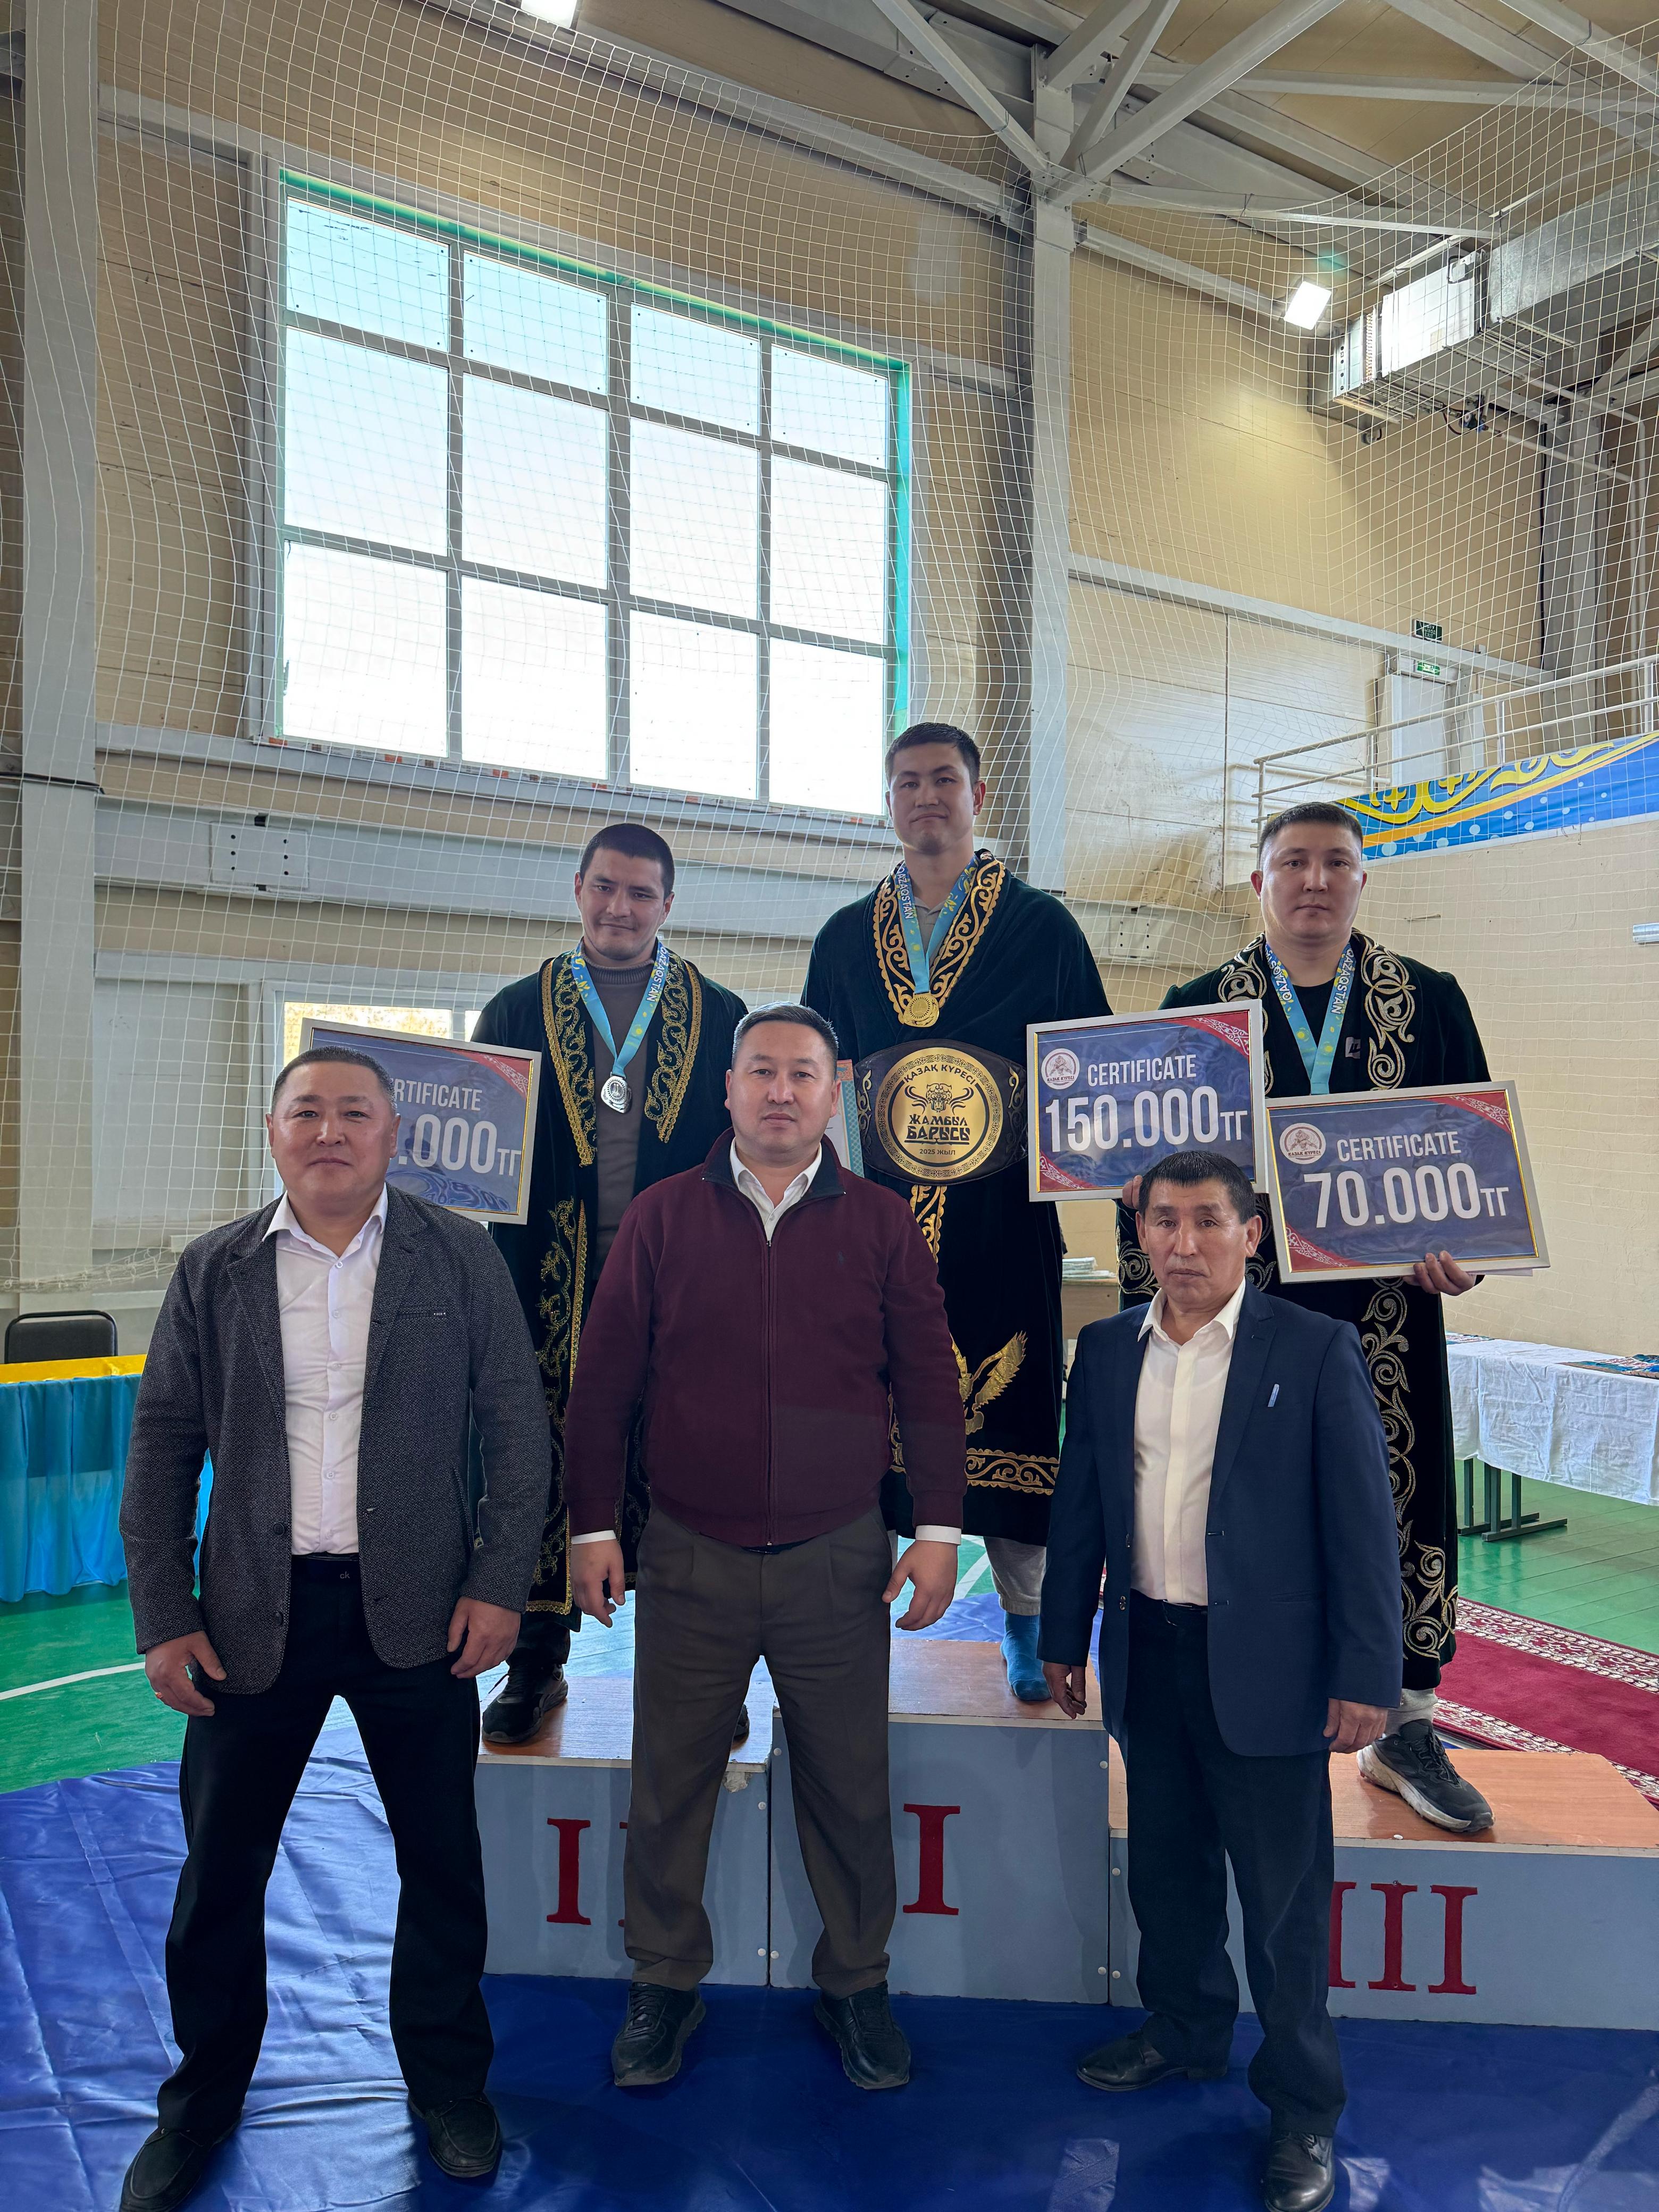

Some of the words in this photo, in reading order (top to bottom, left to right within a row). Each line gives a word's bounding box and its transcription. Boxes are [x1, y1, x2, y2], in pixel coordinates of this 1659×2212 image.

[647, 946, 667, 1002] QAZAQSTAN
[1331, 949, 1354, 1014] QAZAQSTAN
[904, 1064, 939, 1083] ҚАЗАҚ
[941, 1064, 976, 1085] КҮРЕСІ
[1087, 1054, 1196, 1087] CERTIFICATE
[392, 1078, 482, 1111] RTIFICATE
[906, 1125, 970, 1141] БАРЫСЫ
[909, 1113, 968, 1126] ЖАМБЫЛ
[1336, 1131, 1462, 1162] CERTIFICATE
[547, 1817, 628, 1928] I
[903, 1803, 960, 1915] I
